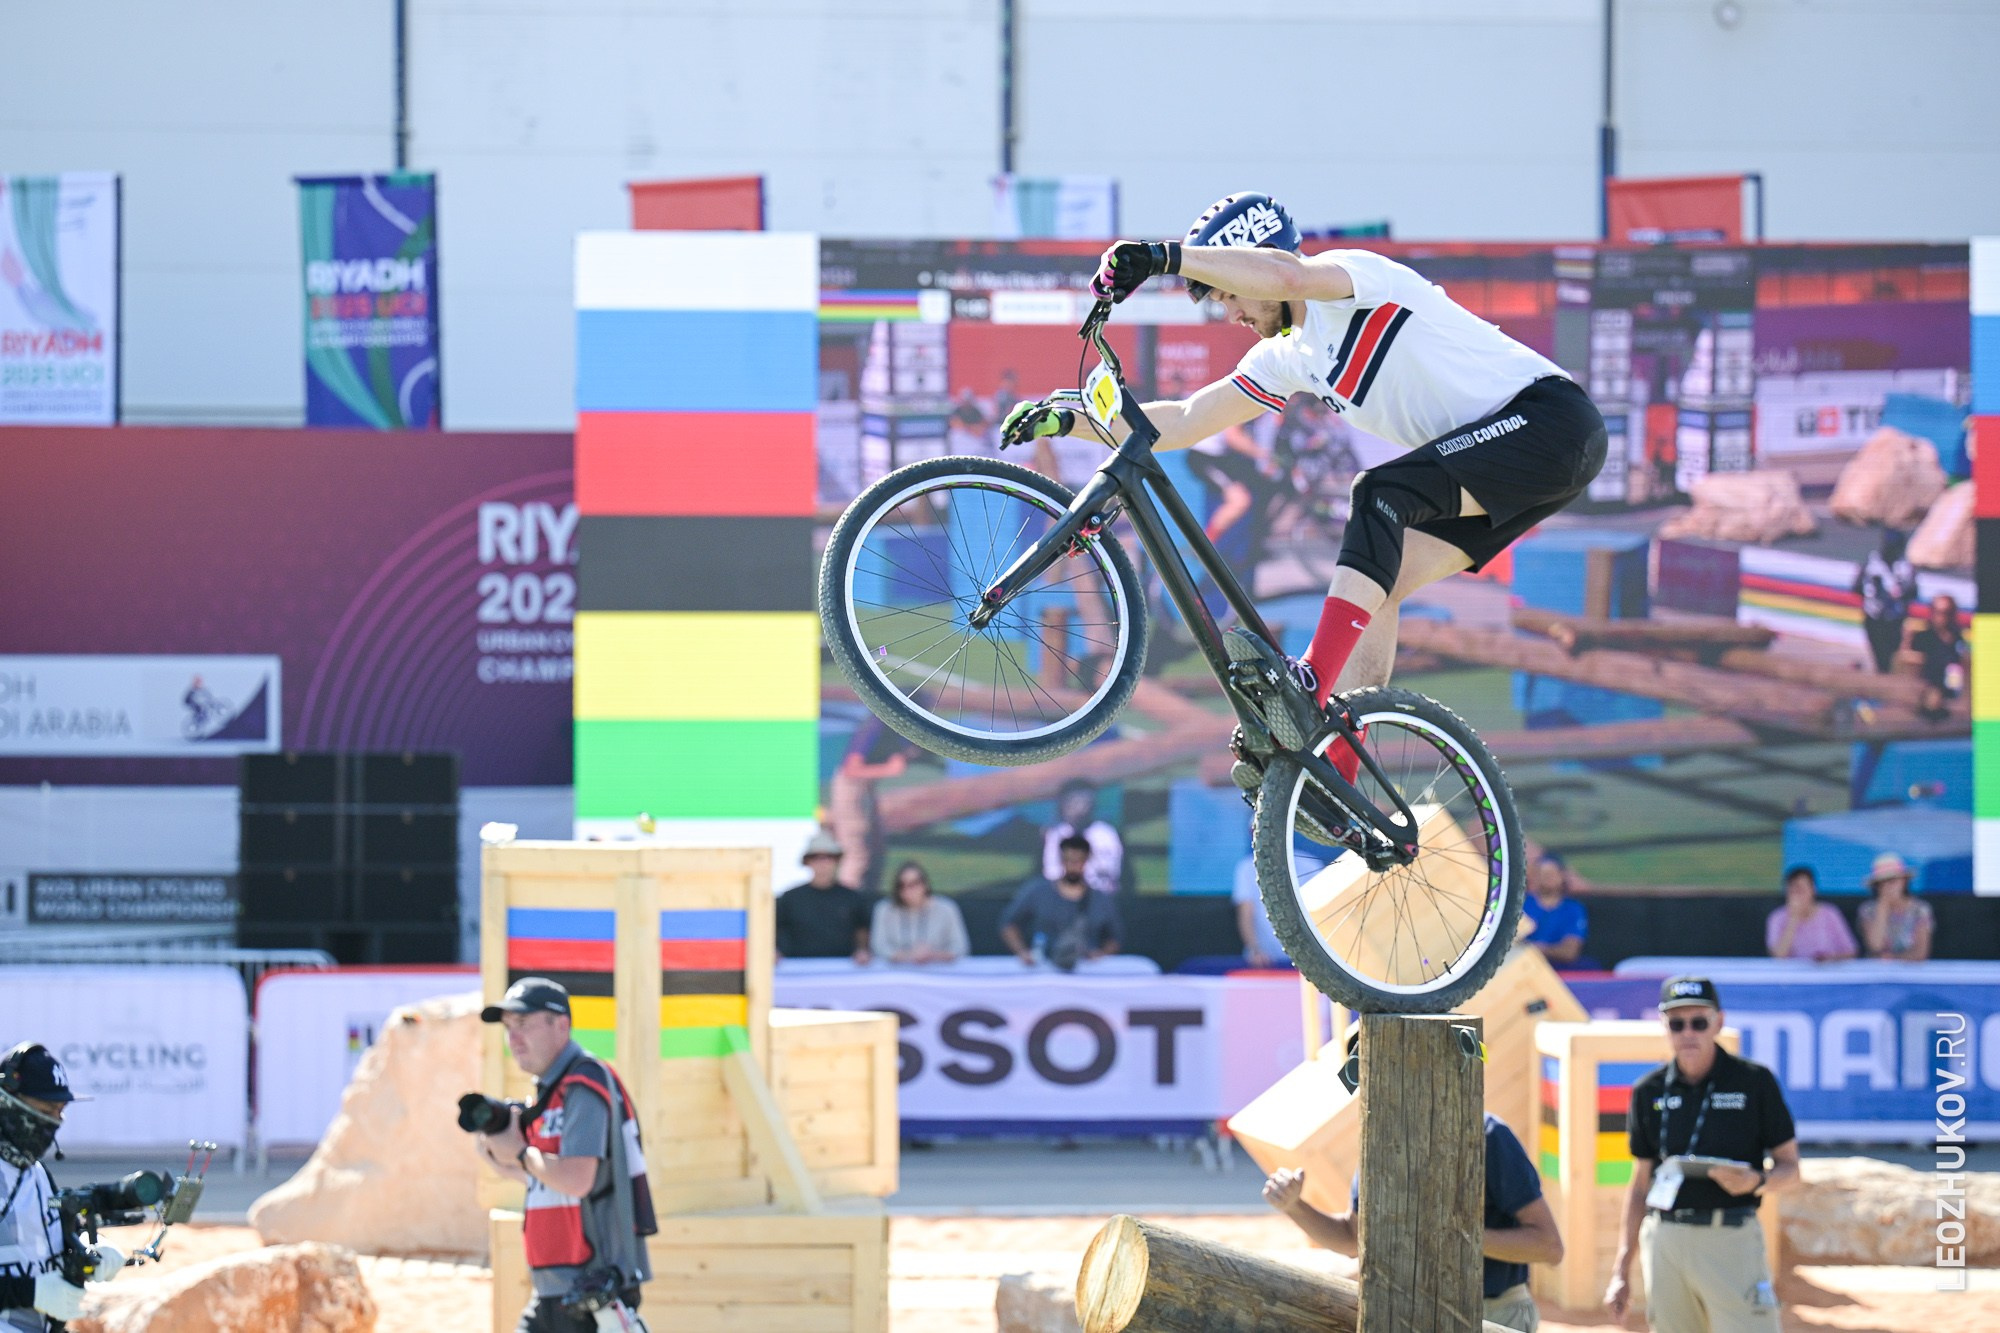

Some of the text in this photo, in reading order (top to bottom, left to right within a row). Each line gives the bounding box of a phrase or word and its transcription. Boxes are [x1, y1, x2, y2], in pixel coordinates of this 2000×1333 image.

[1208, 202, 1278, 247] TRIAL
[1232, 212, 1284, 247] KES
[307, 258, 426, 293] RIYADH
[1, 330, 103, 357] RIYADH
[1097, 391, 1107, 408] 1
[1435, 414, 1528, 457] MIND CONTROL
[478, 502, 579, 566] RIY
[25, 705, 133, 739] ARABIA
[61, 1042, 208, 1070] CYCLING
[1722, 1010, 2000, 1091] MAN
